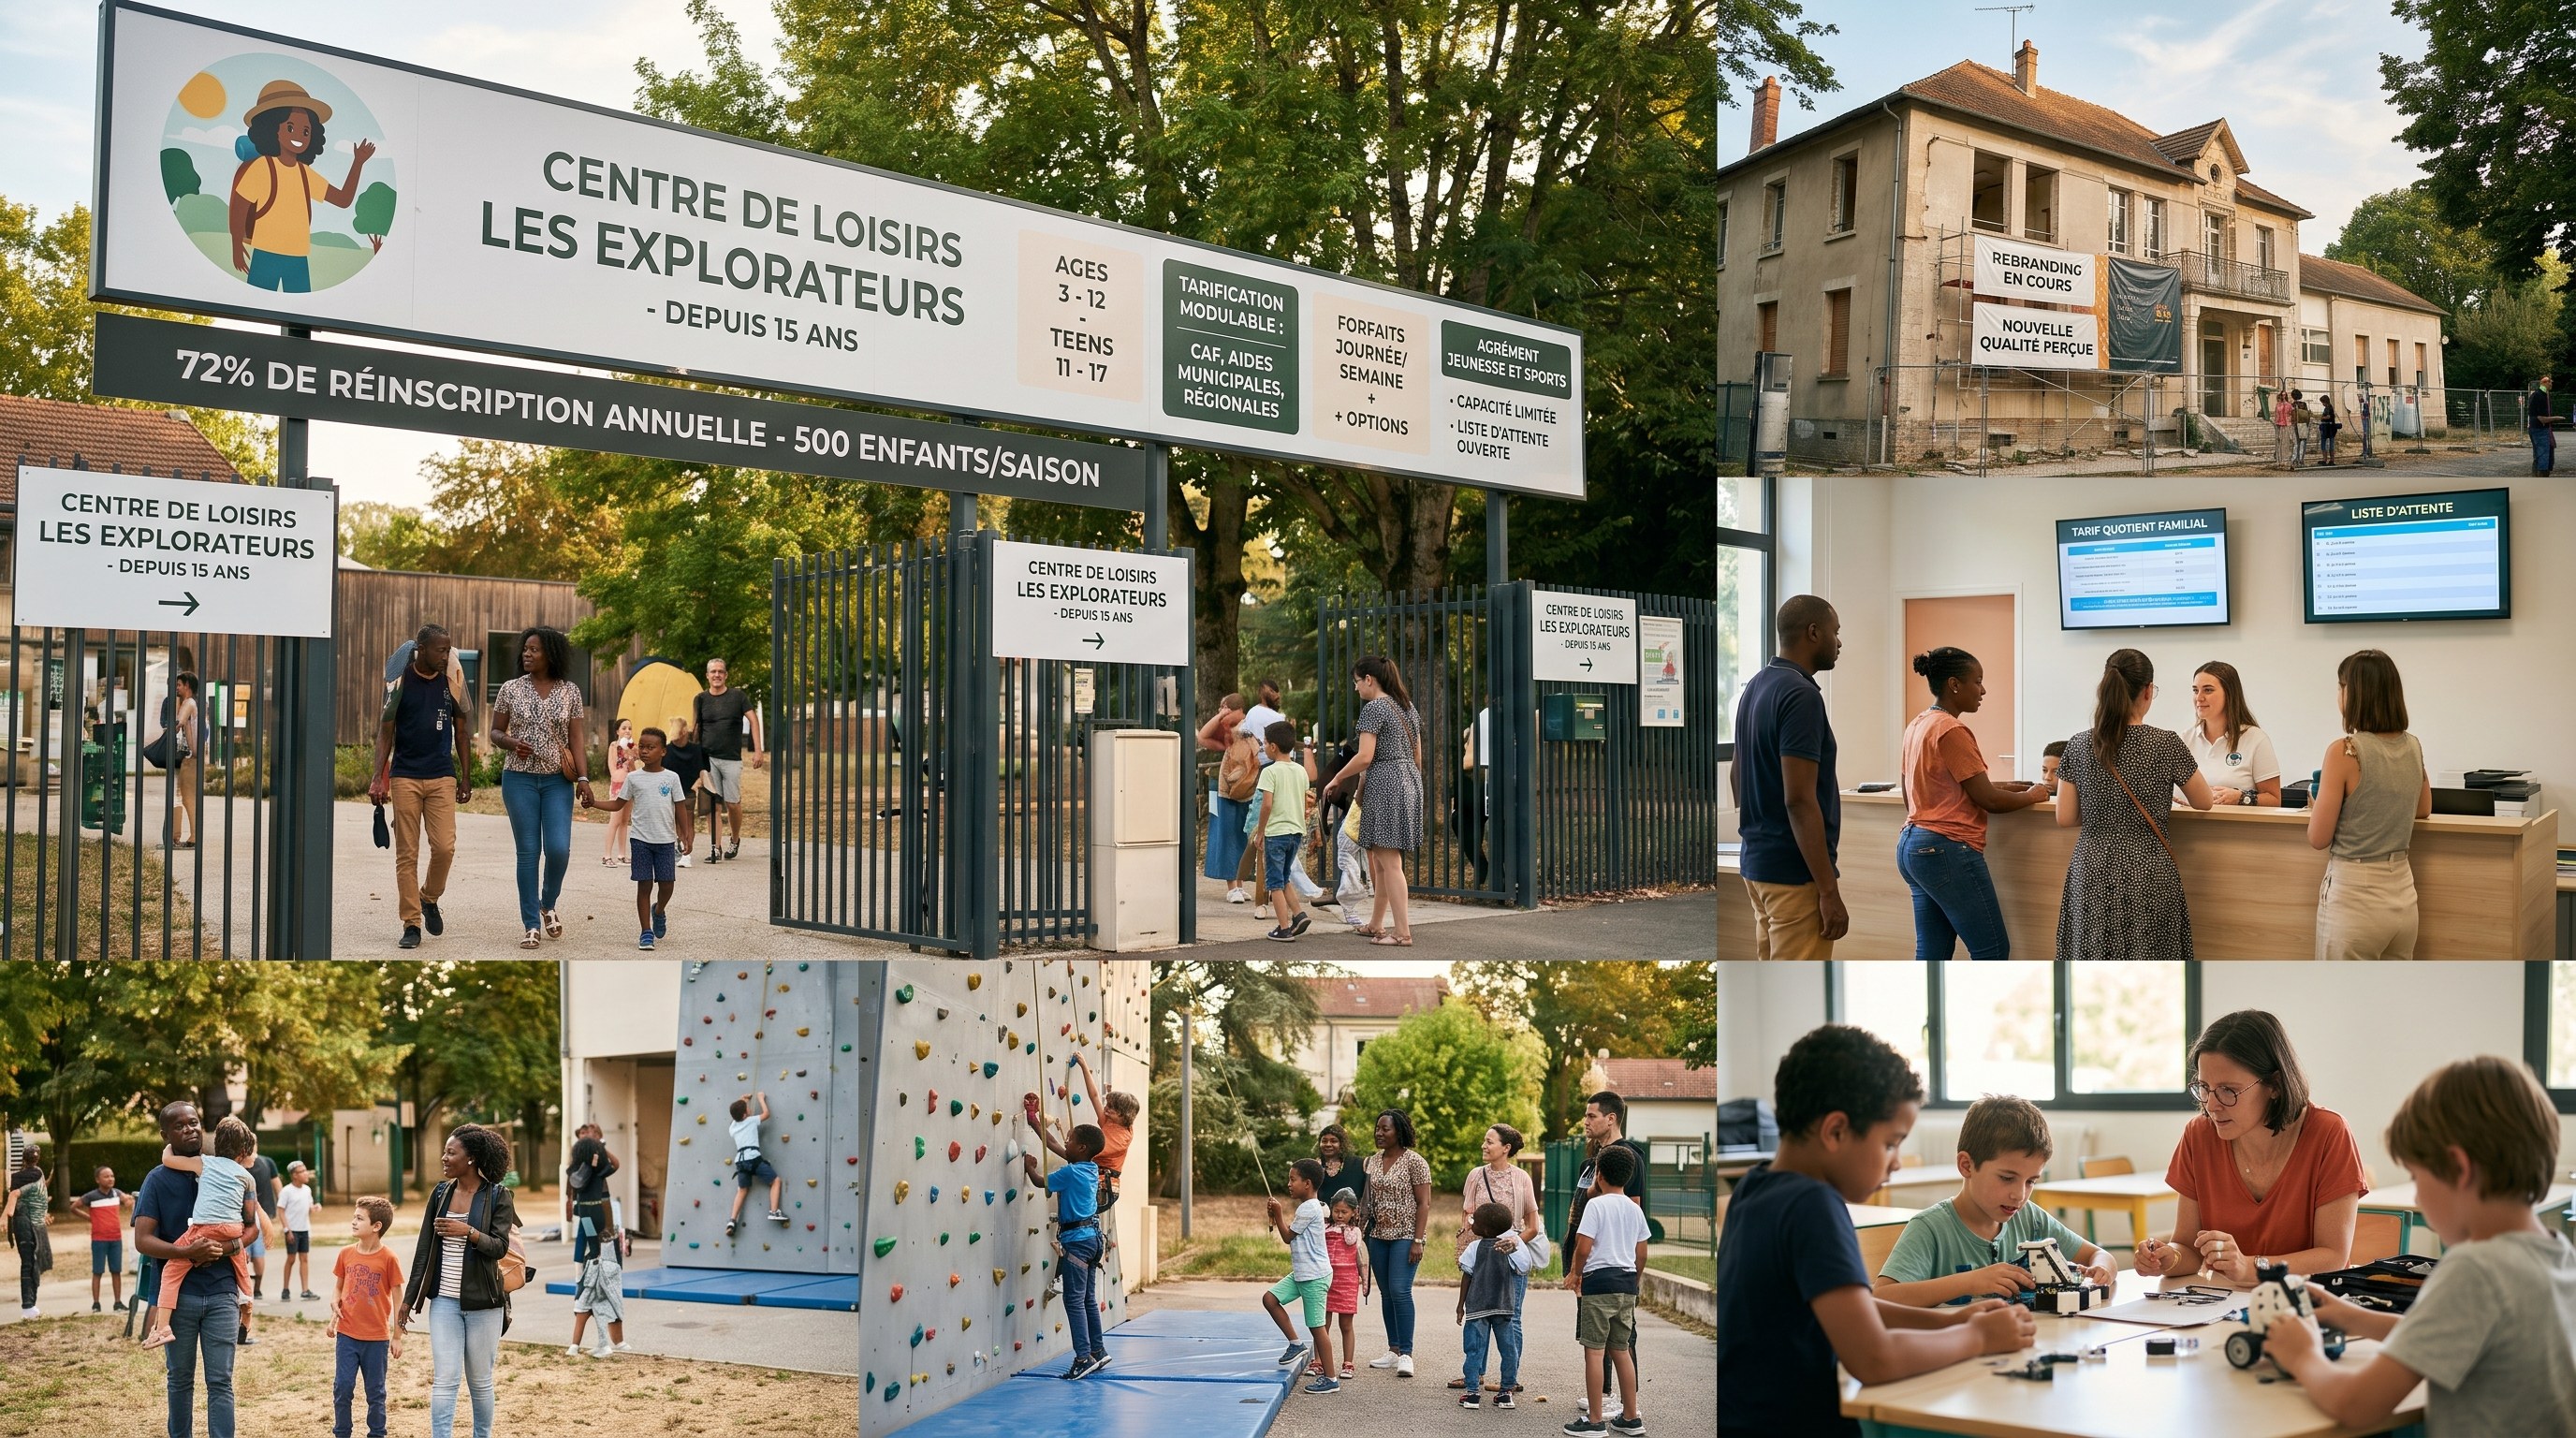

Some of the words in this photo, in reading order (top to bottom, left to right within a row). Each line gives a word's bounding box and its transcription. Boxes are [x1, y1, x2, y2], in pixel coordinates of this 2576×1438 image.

[543, 152, 726, 223] CENTRE
[743, 190, 798, 237] DE
[814, 204, 962, 268] LOISIRS
[482, 200, 578, 259] LES
[597, 222, 964, 328] EXPLORATEURS
[1055, 256, 1108, 282] AGES
[1993, 252, 2082, 276] REBRANDING
[1178, 275, 1283, 312] TARIFICATION
[2004, 271, 2022, 286] EN
[2027, 275, 2071, 292] COURS
[1059, 284, 1069, 302] 3
[1088, 289, 1105, 309] 12
[666, 300, 767, 337] DEPUIS
[774, 317, 798, 343] 15
[806, 324, 857, 352] ANS
[1180, 300, 1276, 333] MODULABLE
[1339, 315, 1405, 343] FORFAITS
[2003, 319, 2072, 338] NOUVELLE
[1050, 328, 1113, 356] TEENS
[1336, 339, 1408, 368] JOURNÉE/
[1477, 339, 1539, 362] AGRÉMENT
[2044, 341, 2093, 358] PERÇUE
[1056, 357, 1070, 377] 11
[1089, 362, 1107, 382] 17
[1191, 344, 1224, 366] CAF,
[1228, 350, 1273, 372] AIDES
[1447, 352, 1505, 375] JEUNESSE
[1509, 364, 1522, 378] ET
[1524, 368, 1566, 388] SPORTS
[1178, 364, 1284, 400] MUNICIPALES,
[1340, 363, 1403, 389] SEMAINE
[1184, 387, 1279, 418] RÉGIONALES
[1457, 395, 1512, 417] CAPACITÉ
[1515, 404, 1557, 424] LIMITÉE
[177, 349, 254, 387] 72%
[268, 361, 316, 394] DE
[329, 366, 593, 426] RÉINSCRIPTION
[603, 404, 766, 448] ANNUELLE
[794, 426, 849, 457] 500
[859, 433, 1100, 488] ENFANTS/SAISON
[1347, 411, 1408, 435] OPTIONS
[1458, 419, 1487, 437] LISTE
[1491, 425, 1548, 448] D'ATTENTE
[1457, 440, 1510, 460] OUVERTE
[62, 493, 159, 518] CENTRE
[168, 501, 199, 521] DE
[208, 505, 296, 528] LOISIRS
[2352, 507, 2383, 519] LISTE
[2387, 502, 2453, 516] D'ATTENTE
[40, 521, 91, 545] LES
[101, 525, 314, 559] EXPLORATEURS
[2071, 526, 2100, 536] TARIF
[2102, 522, 2156, 536] QUOTIENT
[2159, 519, 2207, 531] FAMILIAL
[120, 559, 186, 576] DEPUIS
[192, 563, 208, 577] 15
[213, 565, 250, 580] ANS
[1029, 561, 1082, 578] CENTRE
[1087, 565, 1104, 580] DE
[1108, 567, 1156, 584] LOISIRS
[1017, 581, 1045, 598] LES
[1050, 584, 1166, 608] EXPLORATEURS
[1061, 608, 1098, 621] DEPUIS
[1100, 610, 1110, 622] 15
[1112, 612, 1133, 623] ANS
[1546, 604, 1578, 617] CENTRE
[1581, 607, 1591, 618] DE
[1594, 609, 1623, 621] LOISIRS
[1540, 620, 1557, 633] LES
[1565, 639, 1588, 649] DEPUIS
[1598, 642, 1611, 651] ANS
